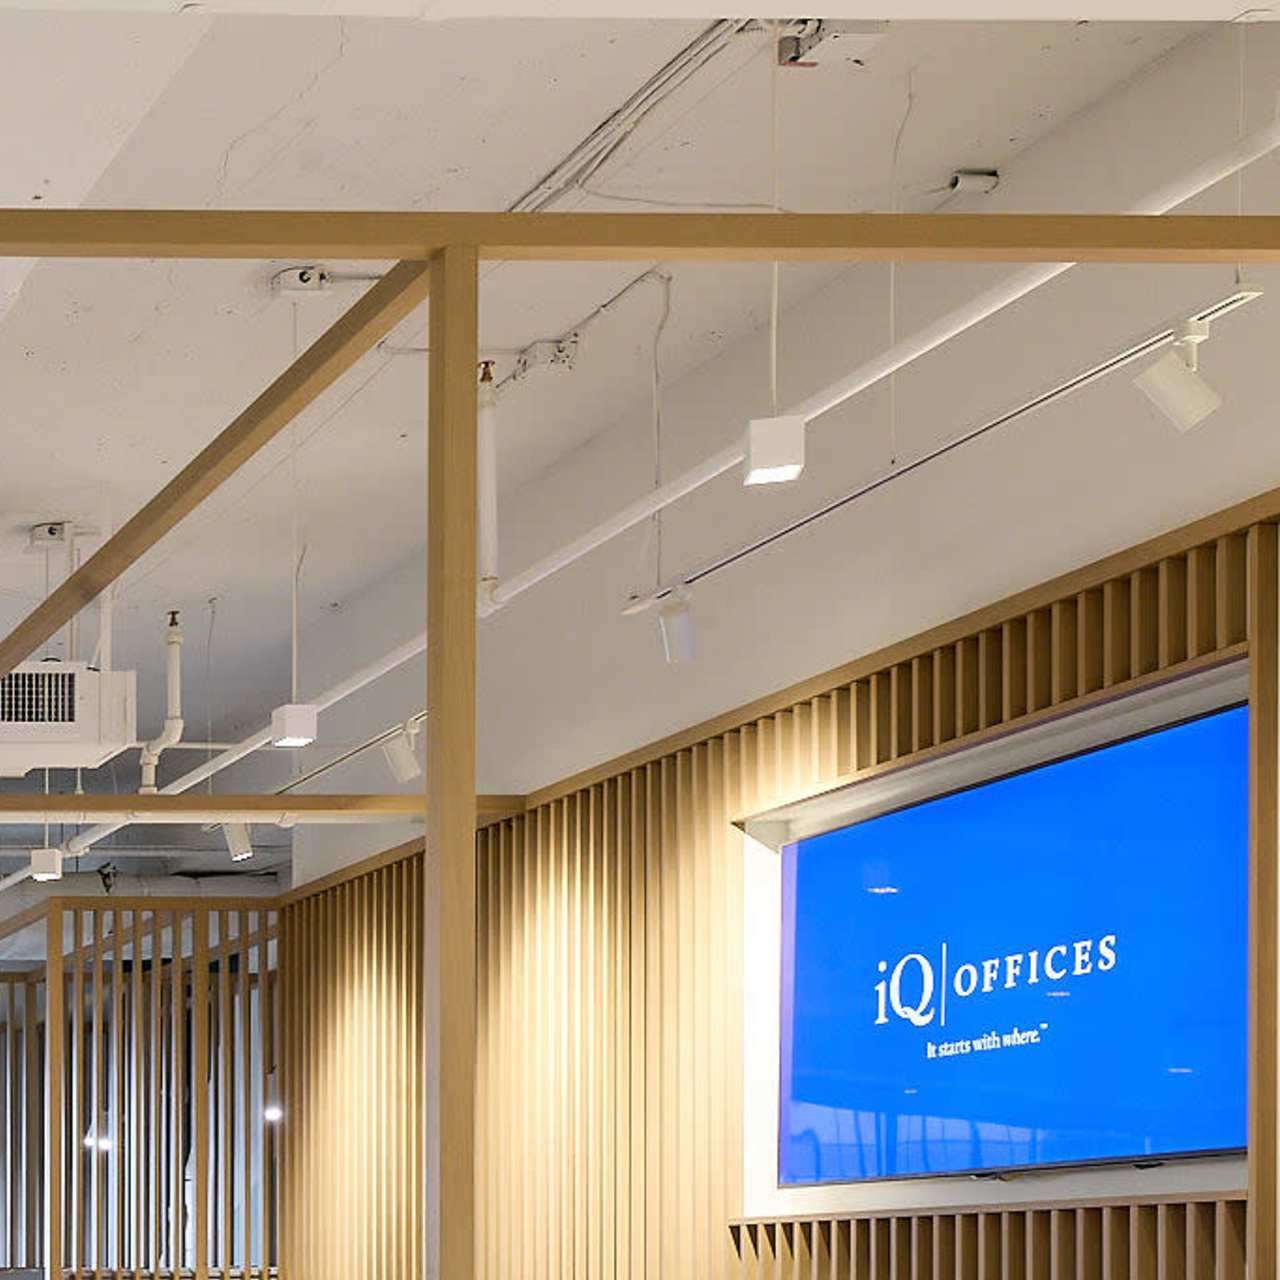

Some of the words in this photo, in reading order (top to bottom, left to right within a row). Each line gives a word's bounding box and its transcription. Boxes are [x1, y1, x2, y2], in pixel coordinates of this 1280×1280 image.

[874, 953, 935, 1027] iQ
[953, 934, 1117, 997] OFFICES
[926, 1041, 938, 1059] It
[938, 1039, 972, 1058] starts
[972, 1030, 1001, 1051] with
